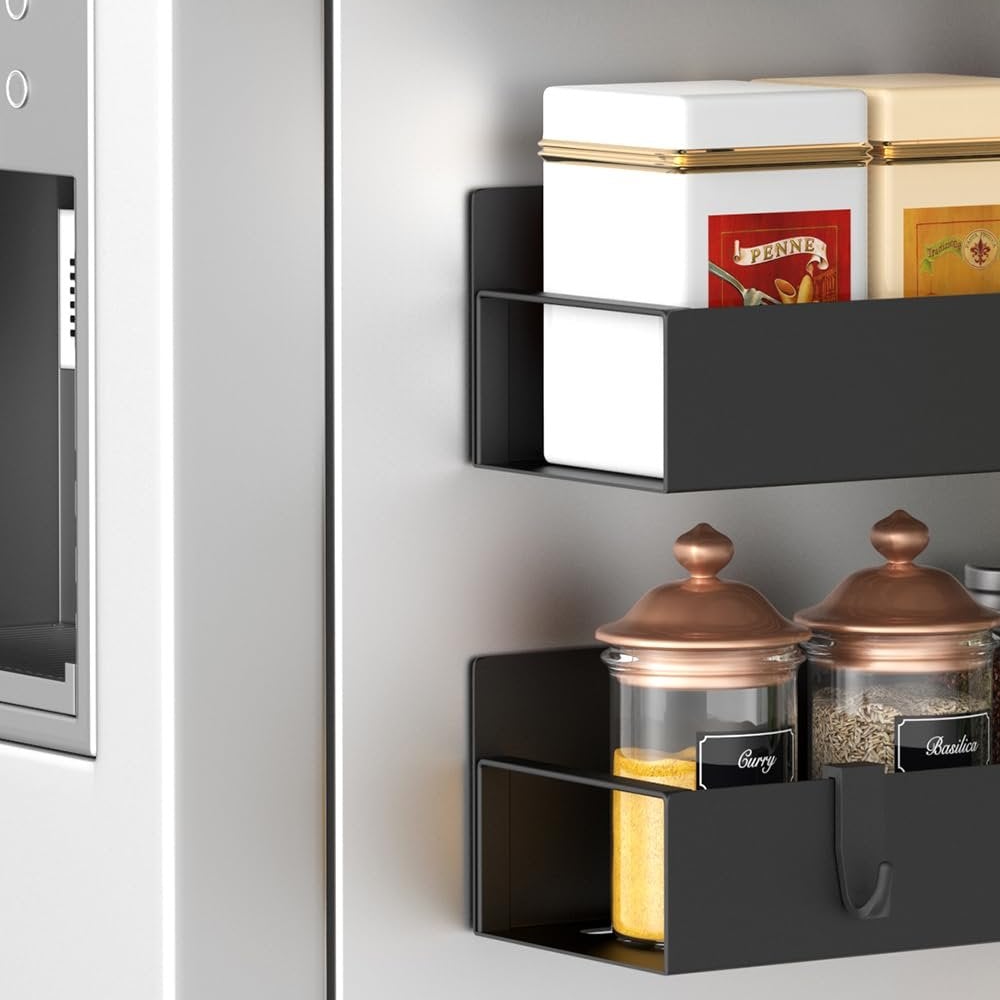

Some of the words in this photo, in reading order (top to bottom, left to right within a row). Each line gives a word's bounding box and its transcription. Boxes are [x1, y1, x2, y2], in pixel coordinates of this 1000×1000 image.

[750, 237, 815, 264] PENNE
[925, 734, 979, 757] Basilica
[737, 749, 777, 774] Curry
